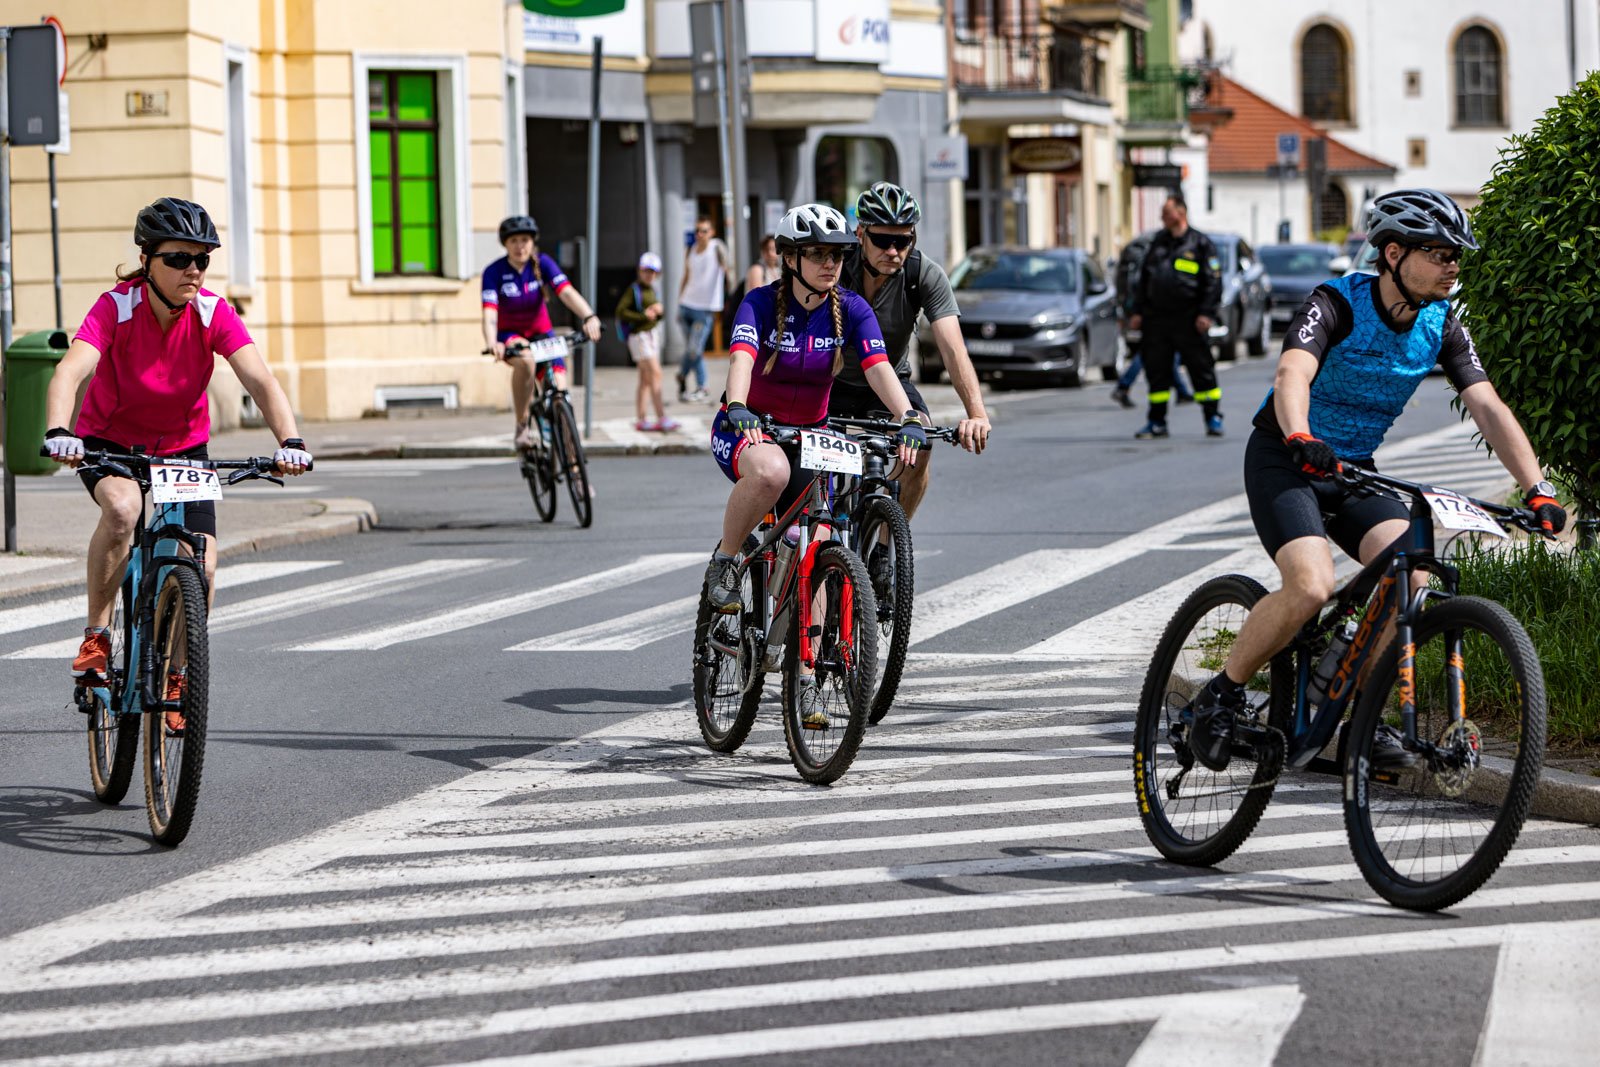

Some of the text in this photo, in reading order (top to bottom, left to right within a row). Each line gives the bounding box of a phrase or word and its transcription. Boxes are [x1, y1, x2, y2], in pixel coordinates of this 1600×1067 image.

[712, 435, 731, 459] DPG
[807, 433, 857, 455] 1840
[157, 469, 214, 483] 1787
[1329, 576, 1397, 700] ORBEA
[1136, 751, 1150, 813] MAXXIS
